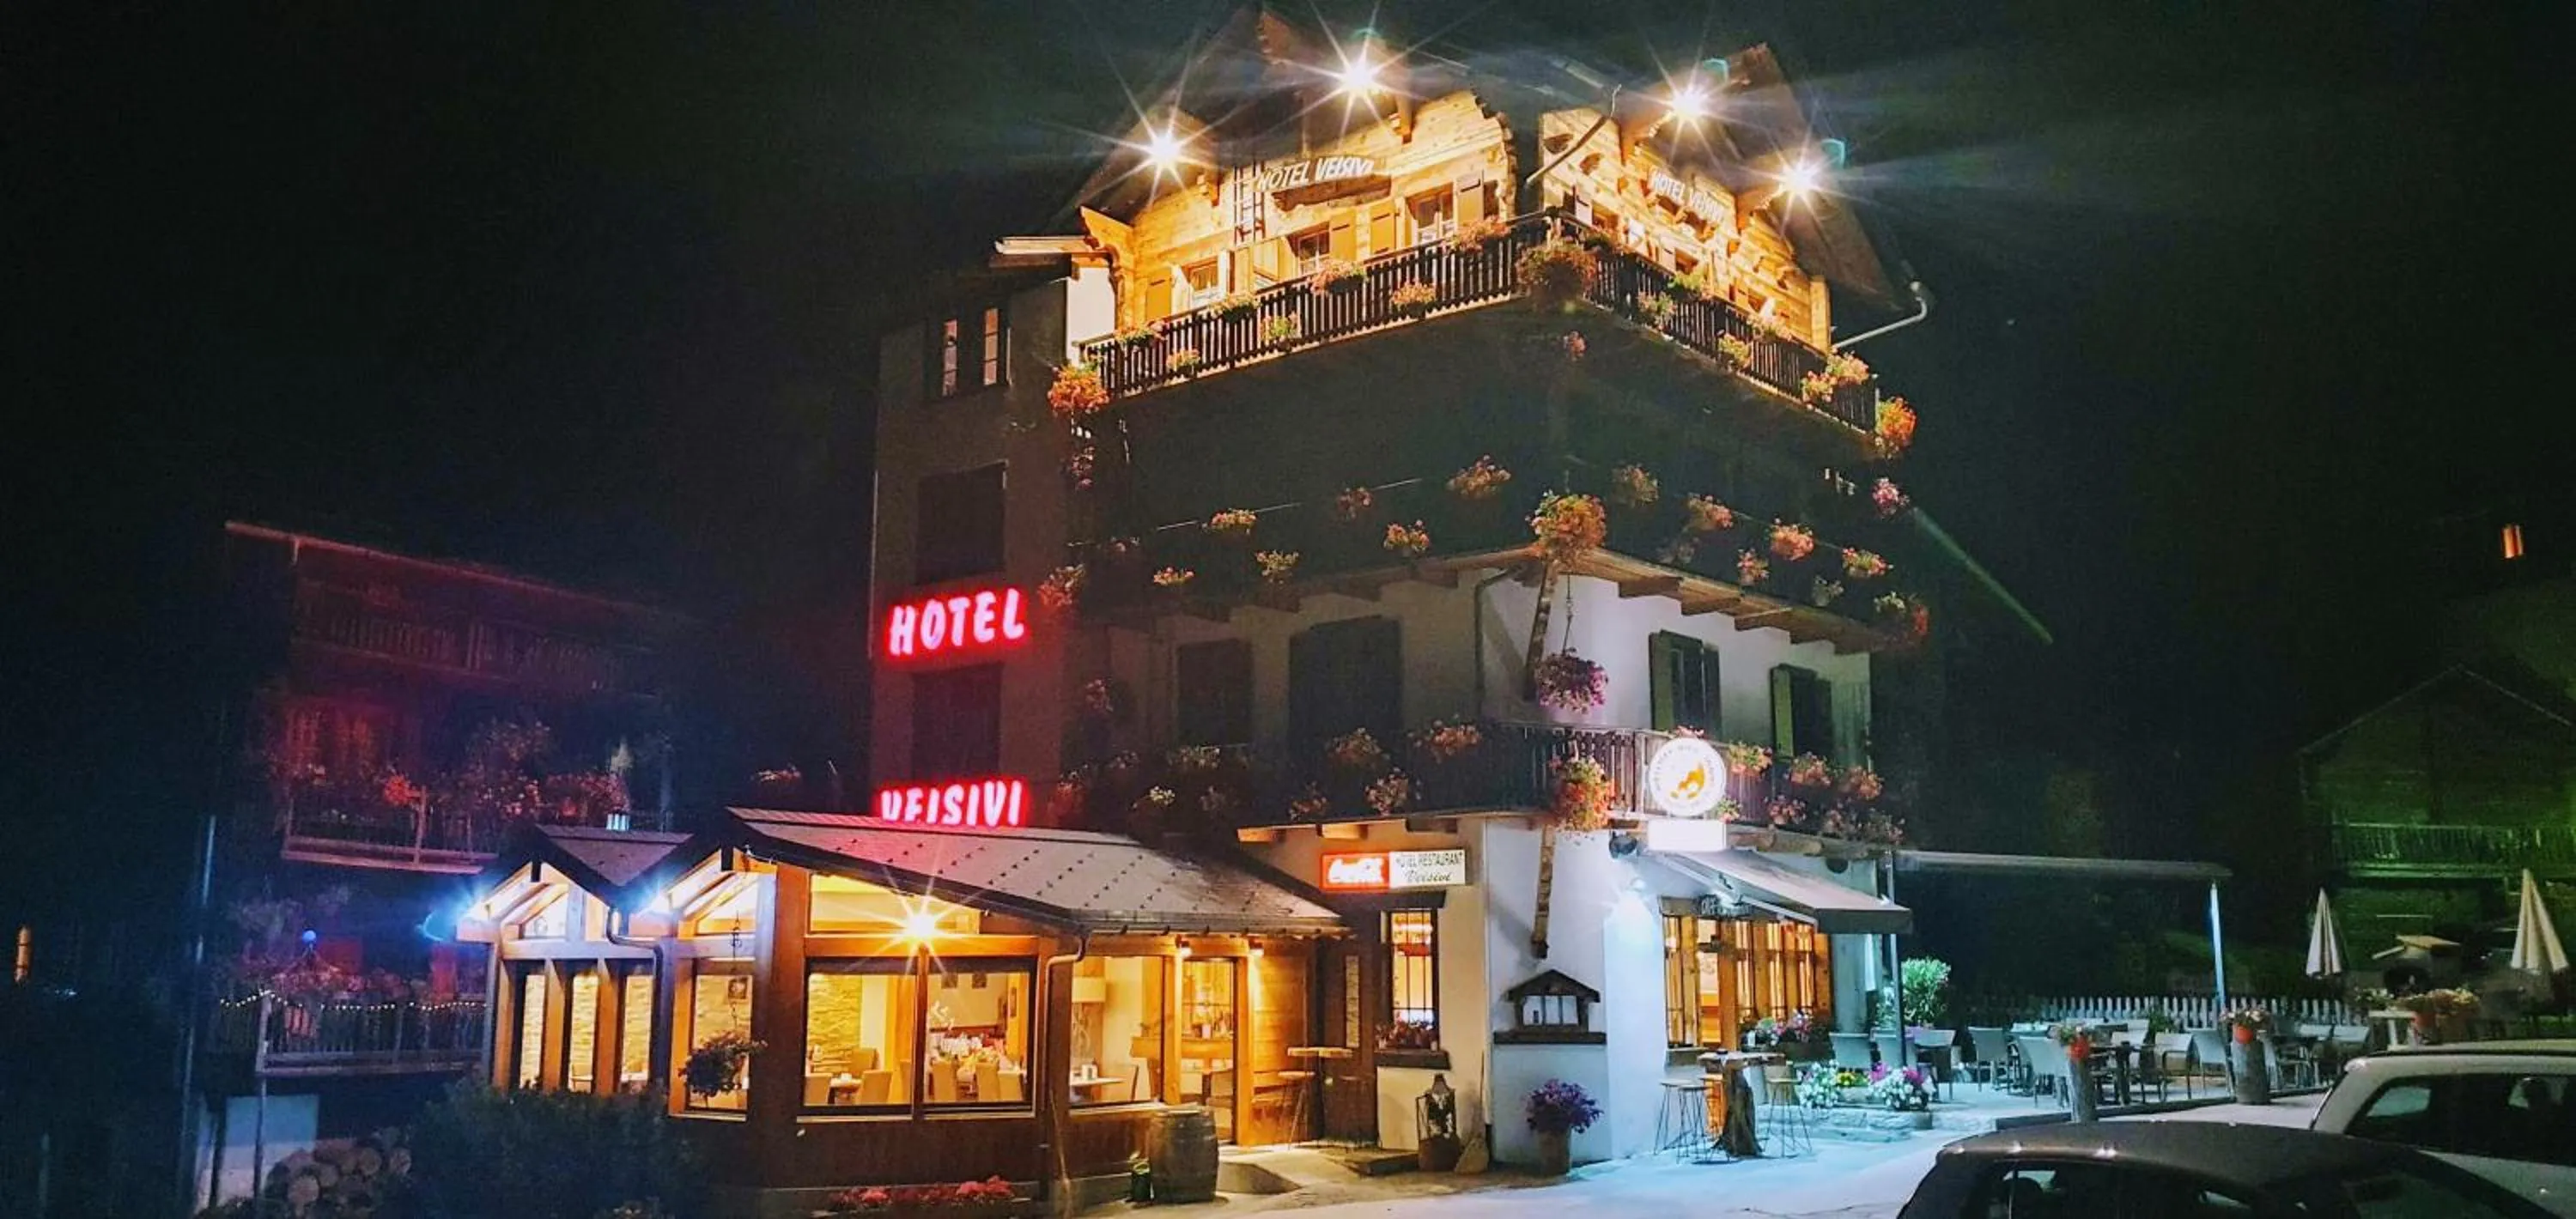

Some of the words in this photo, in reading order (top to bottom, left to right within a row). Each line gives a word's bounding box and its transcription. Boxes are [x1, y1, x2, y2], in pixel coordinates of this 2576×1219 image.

[1256, 161, 1310, 191] HOTEL
[1650, 168, 1686, 206] HOTEL
[889, 587, 1024, 656] HOTEL
[880, 779, 1023, 827] VEISIVI
